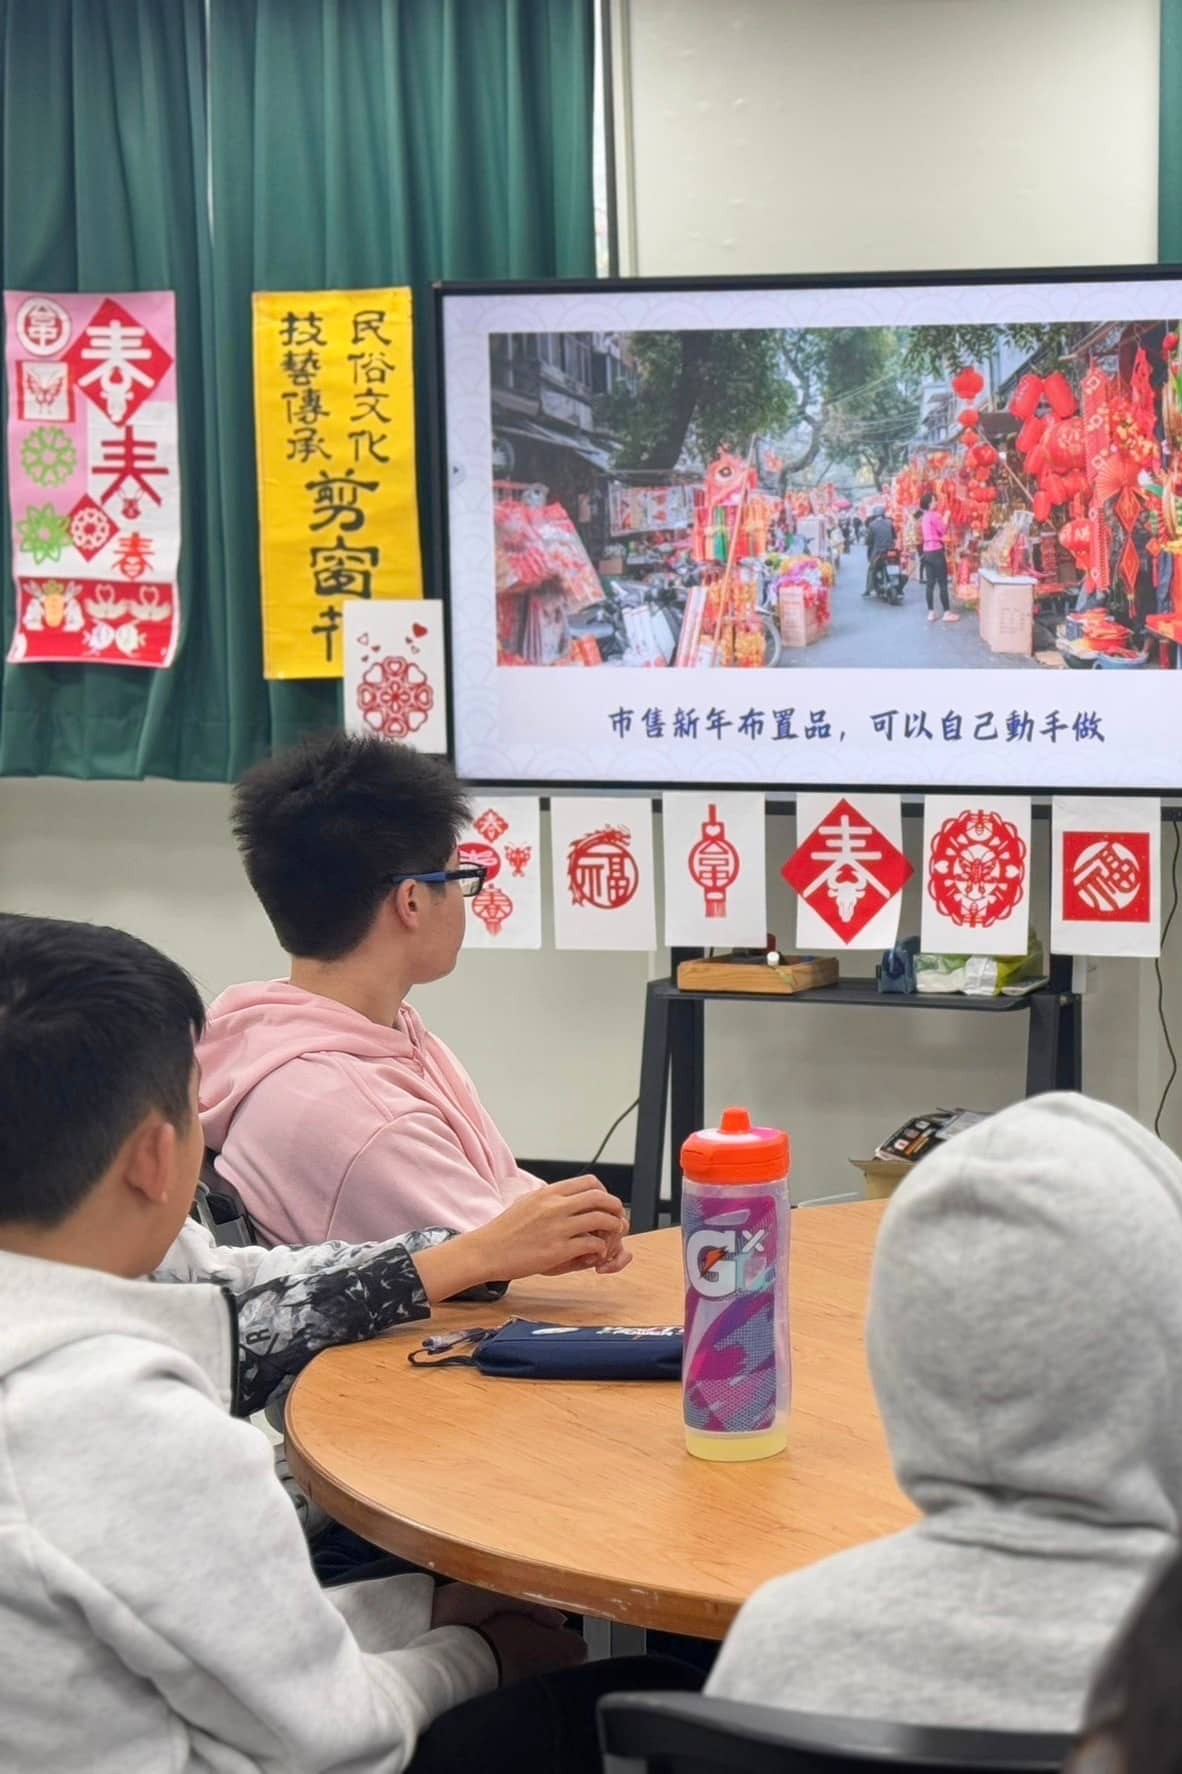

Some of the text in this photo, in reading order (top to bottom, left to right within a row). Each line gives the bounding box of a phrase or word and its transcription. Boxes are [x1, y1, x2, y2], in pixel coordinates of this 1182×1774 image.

[279, 312, 332, 463] 技藝傳承
[348, 310, 396, 463] 民俗文化
